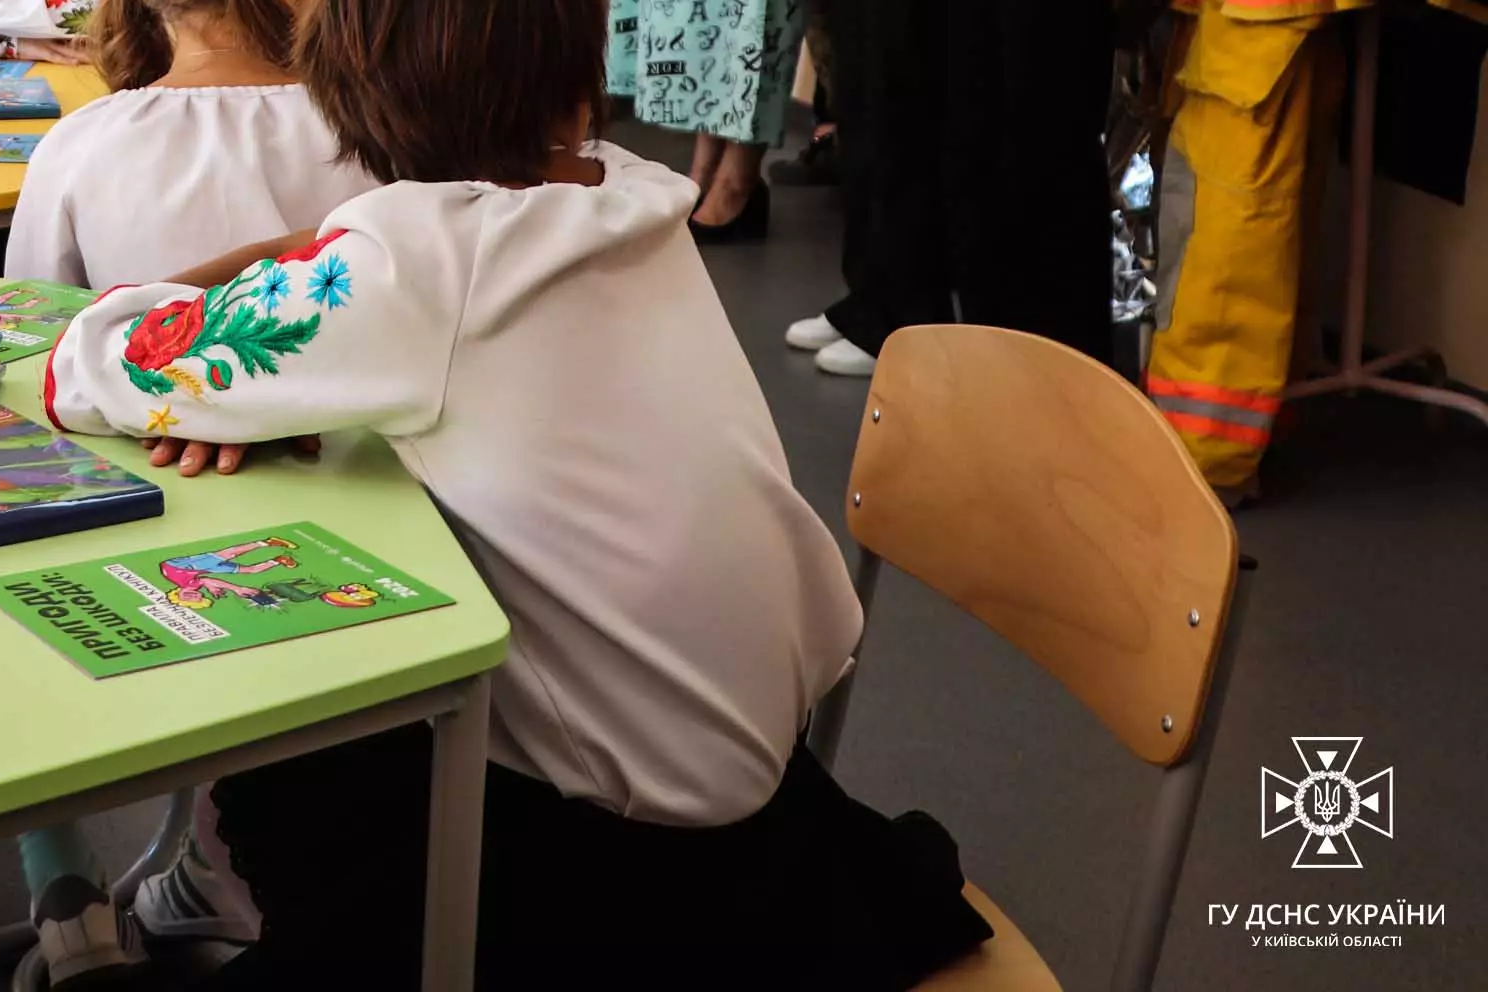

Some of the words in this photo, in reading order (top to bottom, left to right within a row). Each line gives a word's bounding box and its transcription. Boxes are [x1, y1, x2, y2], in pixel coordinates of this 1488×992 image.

[648, 61, 685, 76] FOR
[105, 564, 162, 596] КАНІКУЛ
[34, 571, 133, 627] ШКОДИ:
[3, 580, 133, 661] ПРИГОДИ
[143, 605, 206, 641] ПРАВИЛА
[113, 626, 167, 651] БЕЗ
